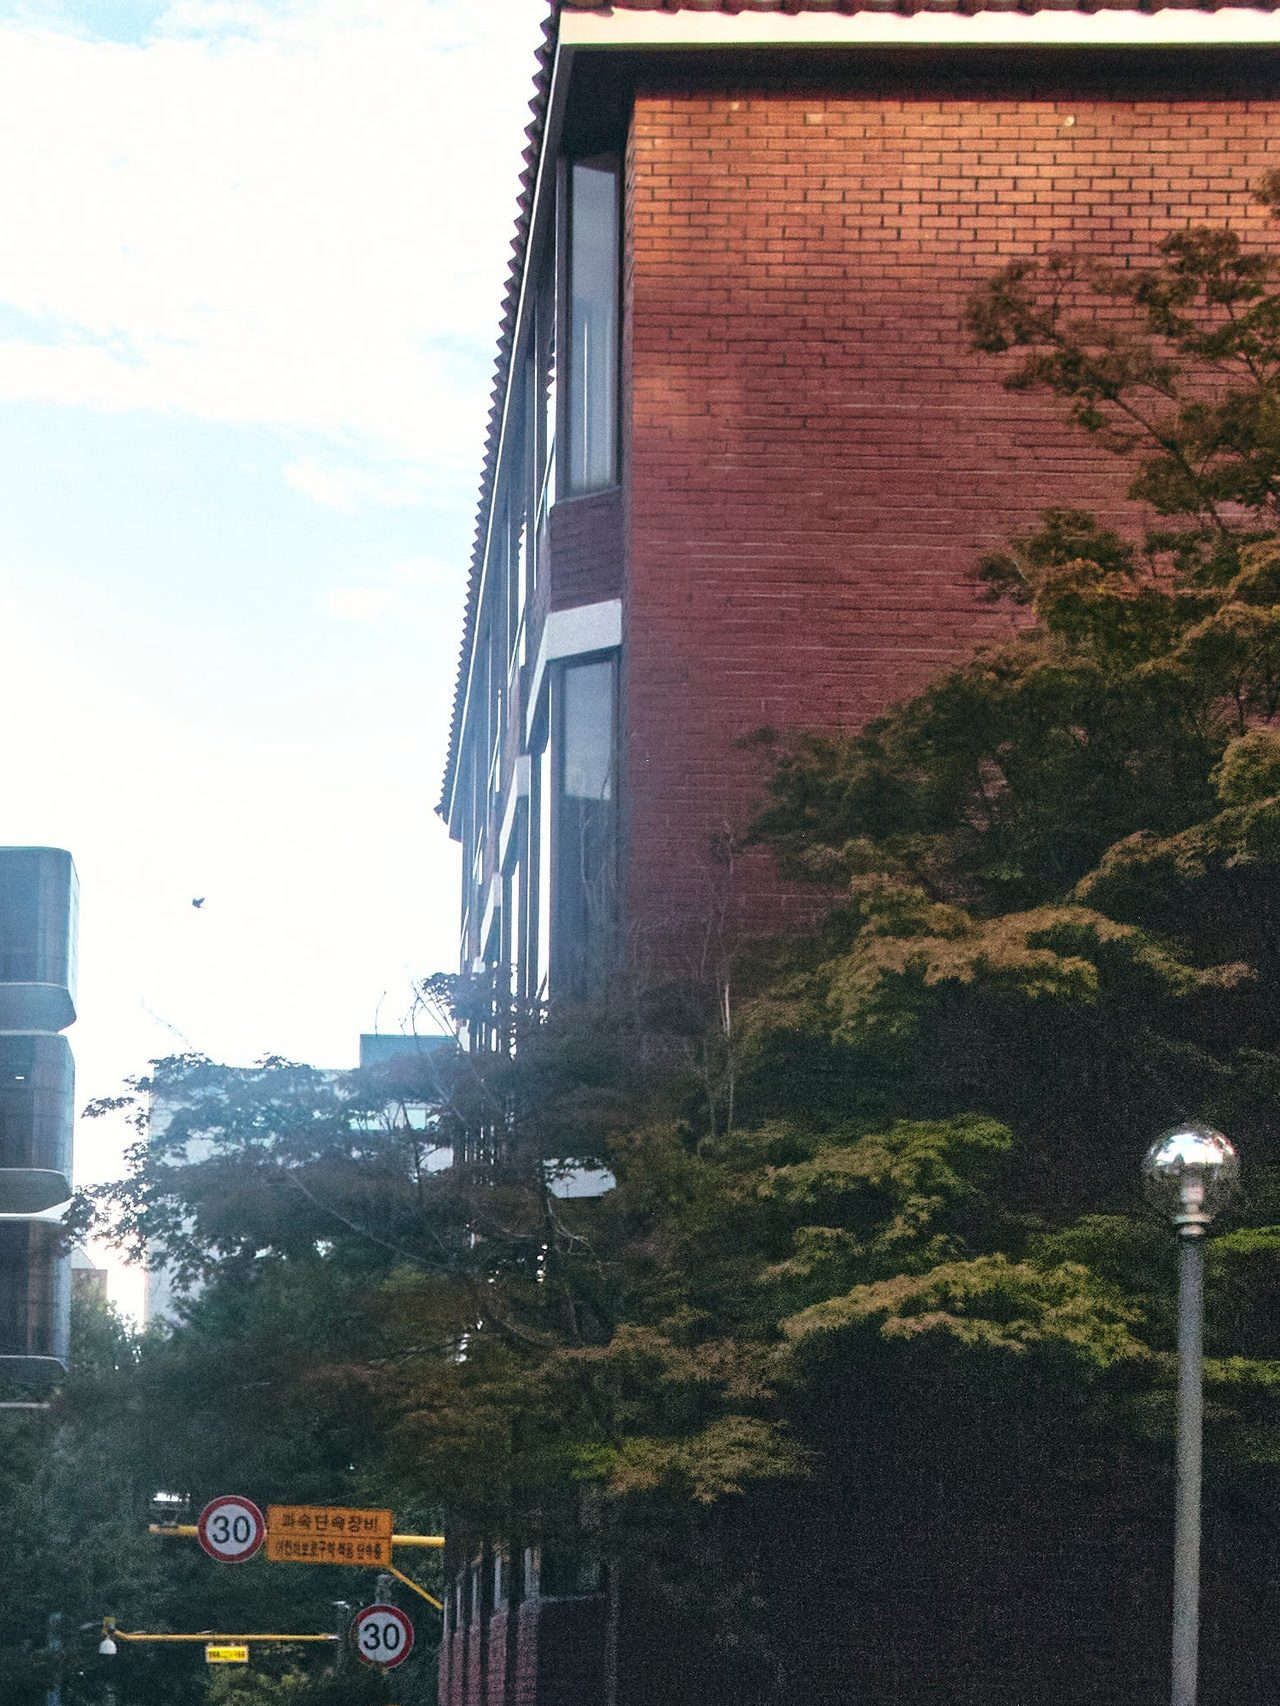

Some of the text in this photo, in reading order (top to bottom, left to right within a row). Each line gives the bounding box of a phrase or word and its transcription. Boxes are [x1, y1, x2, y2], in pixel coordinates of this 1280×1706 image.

[212, 1515, 251, 1544] 30
[282, 1512, 379, 1533] 과속단속장비
[362, 1622, 400, 1651] 30
